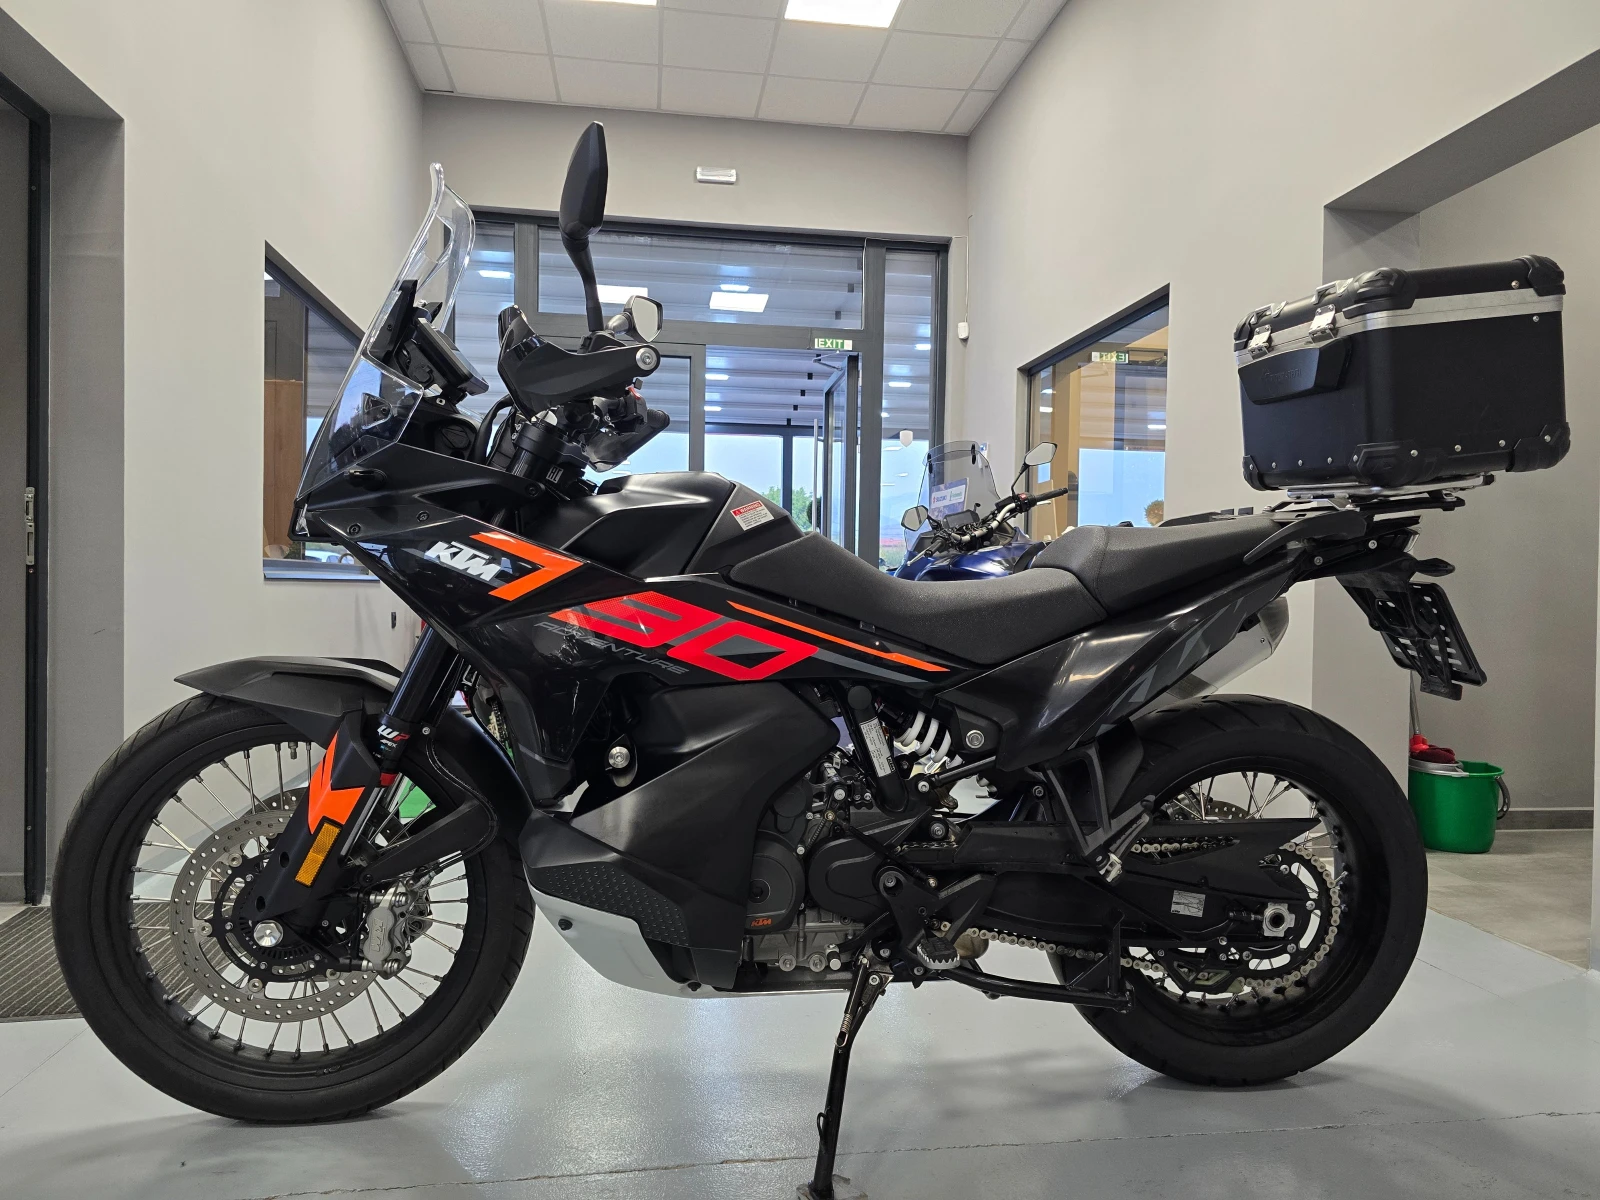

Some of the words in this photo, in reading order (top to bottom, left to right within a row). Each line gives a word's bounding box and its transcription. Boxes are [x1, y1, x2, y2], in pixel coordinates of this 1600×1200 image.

[819, 338, 843, 349] EXIT
[425, 541, 501, 581] KTM
[534, 621, 690, 675] ADVENTURE
[377, 724, 410, 741] WP
[750, 917, 772, 927] KTM
